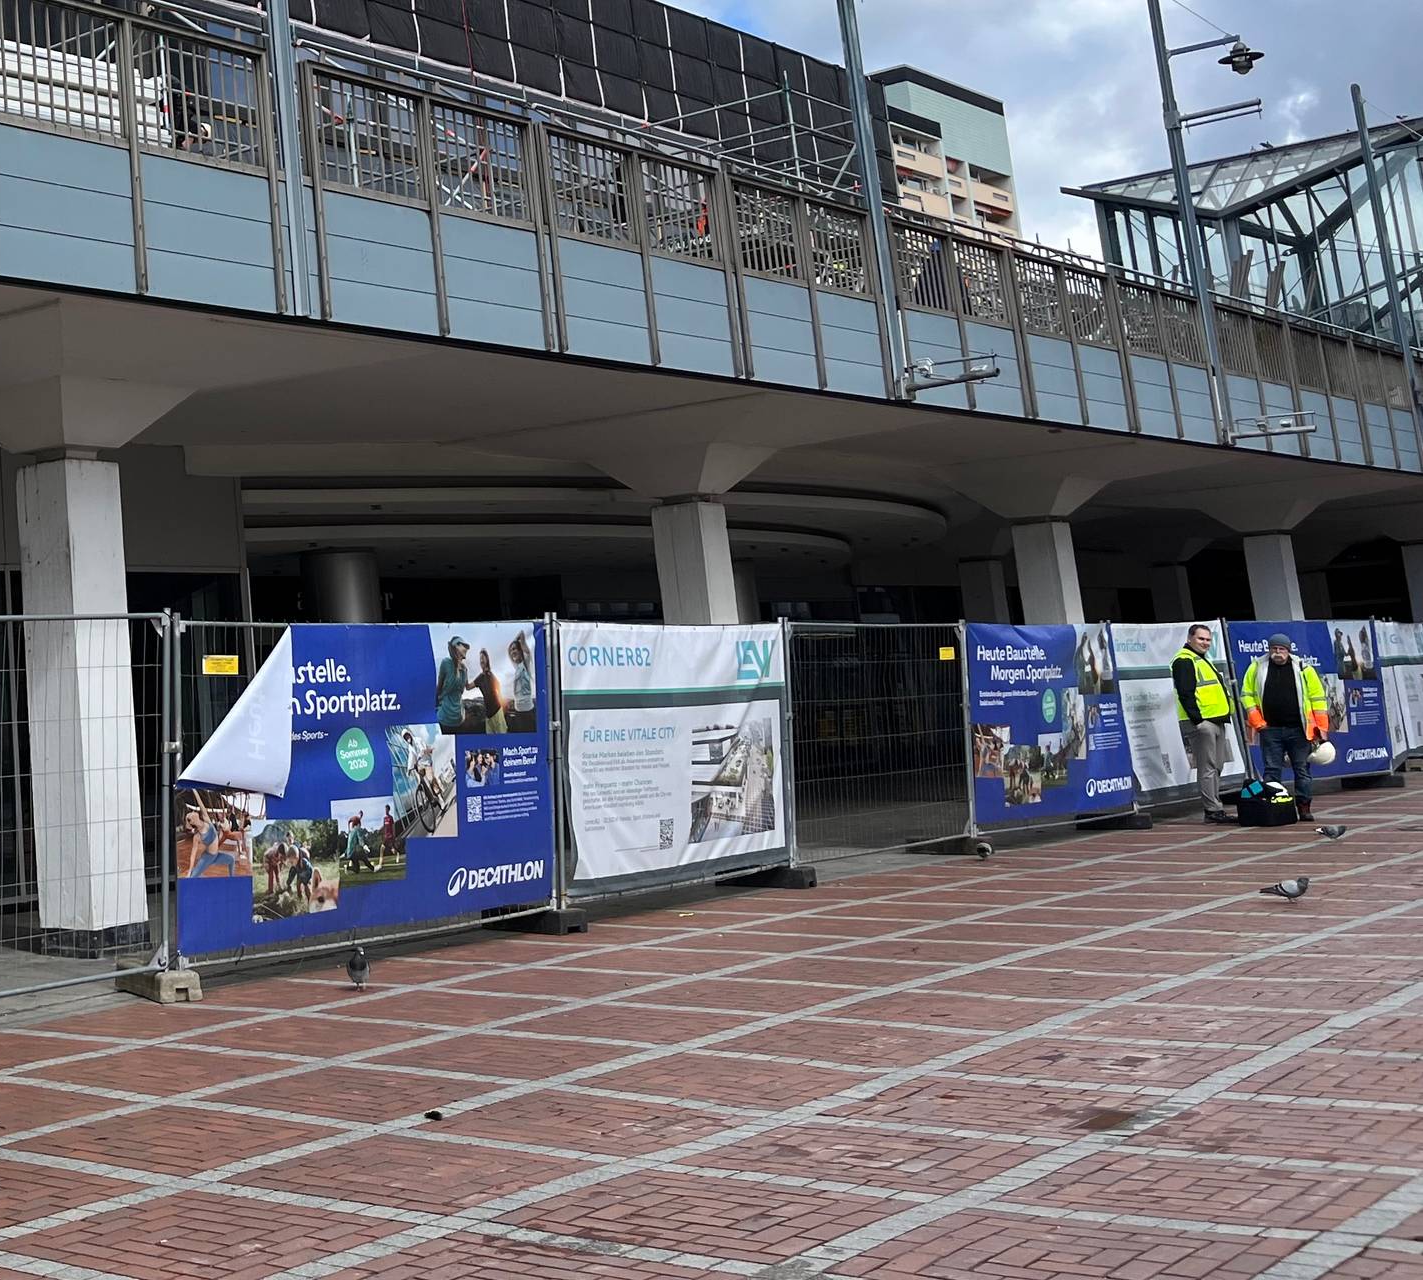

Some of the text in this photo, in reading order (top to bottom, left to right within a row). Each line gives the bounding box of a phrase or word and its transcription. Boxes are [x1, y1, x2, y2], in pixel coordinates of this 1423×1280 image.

[977, 645, 1047, 661] Heute Baustelle.
[1238, 639, 1262, 652] Heute
[568, 646, 651, 666] CORNER82
[291, 658, 351, 684] stelle.
[991, 664, 1063, 684] Morgen Sportplatz.
[304, 687, 401, 720] Sportplatz.
[583, 726, 676, 742] FÜR EINE VITALE CITY
[347, 739, 358, 748] Ab
[502, 747, 517, 756] Mach
[518, 746, 531, 756] Sport
[339, 748, 369, 759] Sommer
[503, 755, 537, 767] deinem Beruf
[1354, 747, 1389, 761] DECATHLON
[348, 760, 368, 770] 2026
[1097, 775, 1132, 794] DECATHLON
[467, 860, 544, 890] DECATHLON
